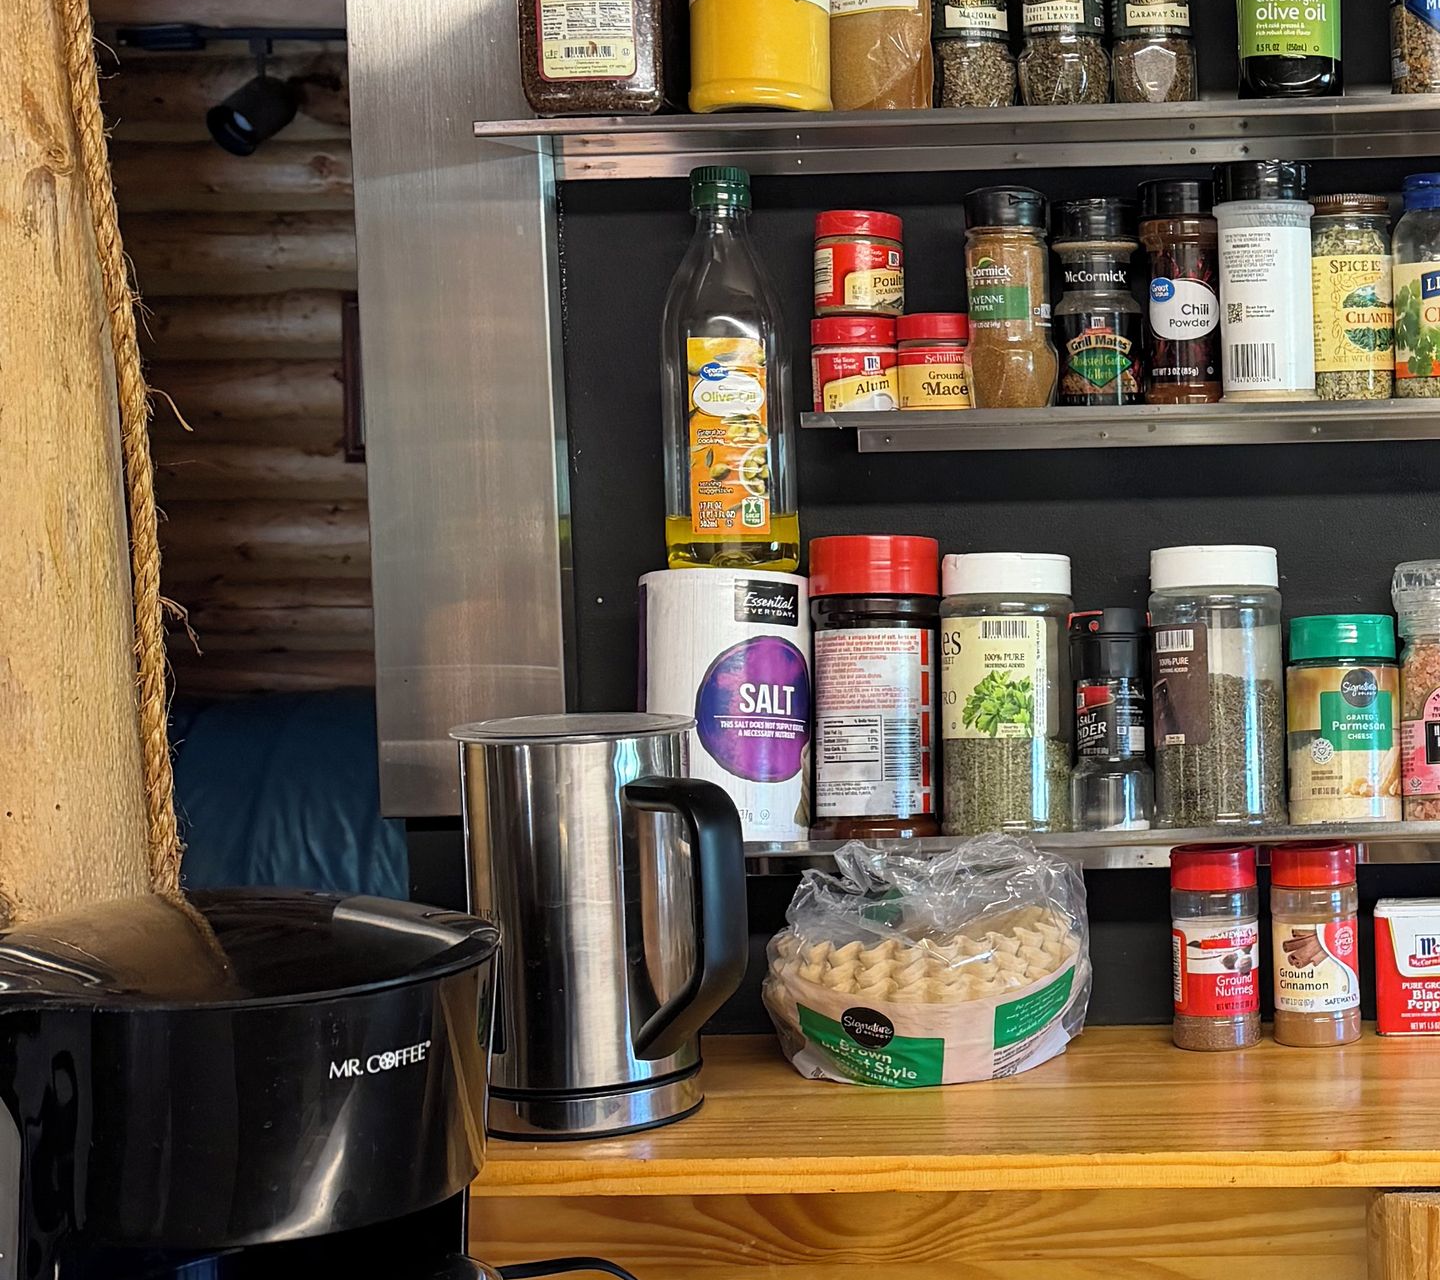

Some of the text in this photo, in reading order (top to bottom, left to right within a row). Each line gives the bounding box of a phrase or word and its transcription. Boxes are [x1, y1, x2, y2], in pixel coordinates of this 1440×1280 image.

[1047, 12, 1079, 20] LEAVES
[1129, 10, 1167, 20] CARAWAY
[1256, 3, 1326, 21] olive oil
[1265, 44, 1272, 52] FL
[1330, 260, 1369, 274] SPICE
[1065, 270, 1126, 284] McCormick
[1152, 284, 1169, 293] Great
[1181, 304, 1210, 316] Chili
[1169, 318, 1210, 328] Powder
[1072, 336, 1127, 350] Grill Mates
[1073, 355, 1103, 367] Roasted
[928, 371, 964, 380] Ground
[856, 380, 890, 395] Alum
[922, 382, 969, 396] Mace
[700, 391, 732, 403] Olive
[743, 592, 794, 610] Essential
[985, 653, 1025, 662] 100% PURE
[1159, 656, 1189, 667] 100% PURE
[739, 683, 795, 716] SALT
[734, 721, 749, 729] SALT
[749, 721, 765, 730] DOES
[1080, 713, 1097, 726] SALT
[1332, 721, 1385, 731] Parmesan
[738, 729, 742, 737] A
[1217, 972, 1253, 987] Ground
[1280, 968, 1314, 980] Ground
[1215, 985, 1254, 997] Nutmeg
[1280, 980, 1329, 991] Cinnamon
[1402, 981, 1425, 990] PURE
[843, 1015, 894, 1036] Signature
[1410, 1022, 1419, 1031] NET
[1419, 1022, 1427, 1030] WT
[839, 1039, 892, 1064] Brown
[328, 1042, 426, 1080] MR. COFFEE
[873, 1060, 918, 1080] Style
